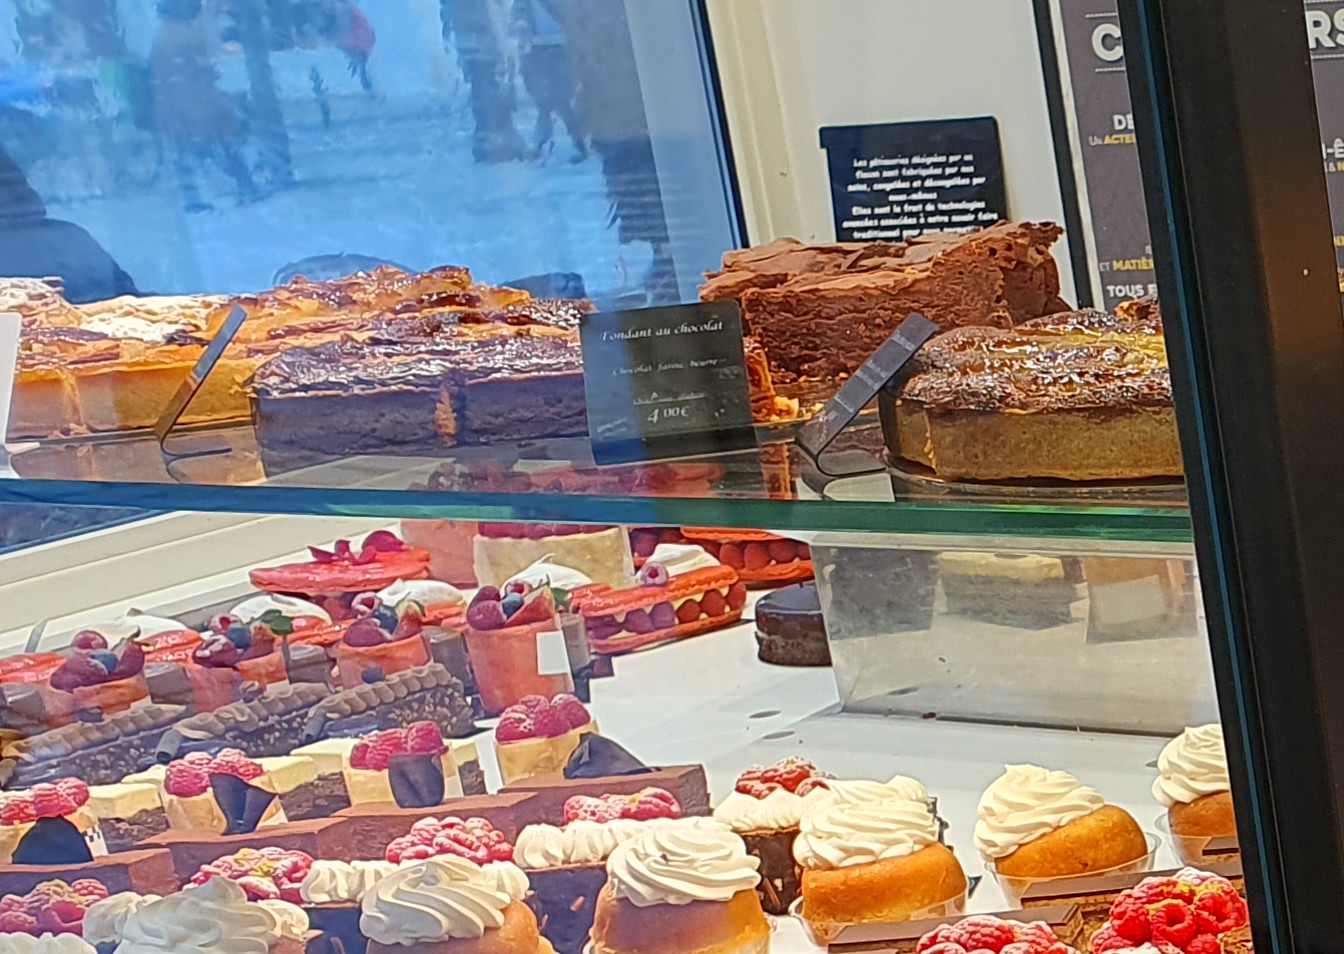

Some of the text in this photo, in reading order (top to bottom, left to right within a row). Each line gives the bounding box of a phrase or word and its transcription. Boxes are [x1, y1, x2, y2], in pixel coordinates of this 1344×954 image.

[1106, 284, 1145, 298] TOUS
[656, 327, 670, 337] au
[674, 320, 724, 335] chocolat
